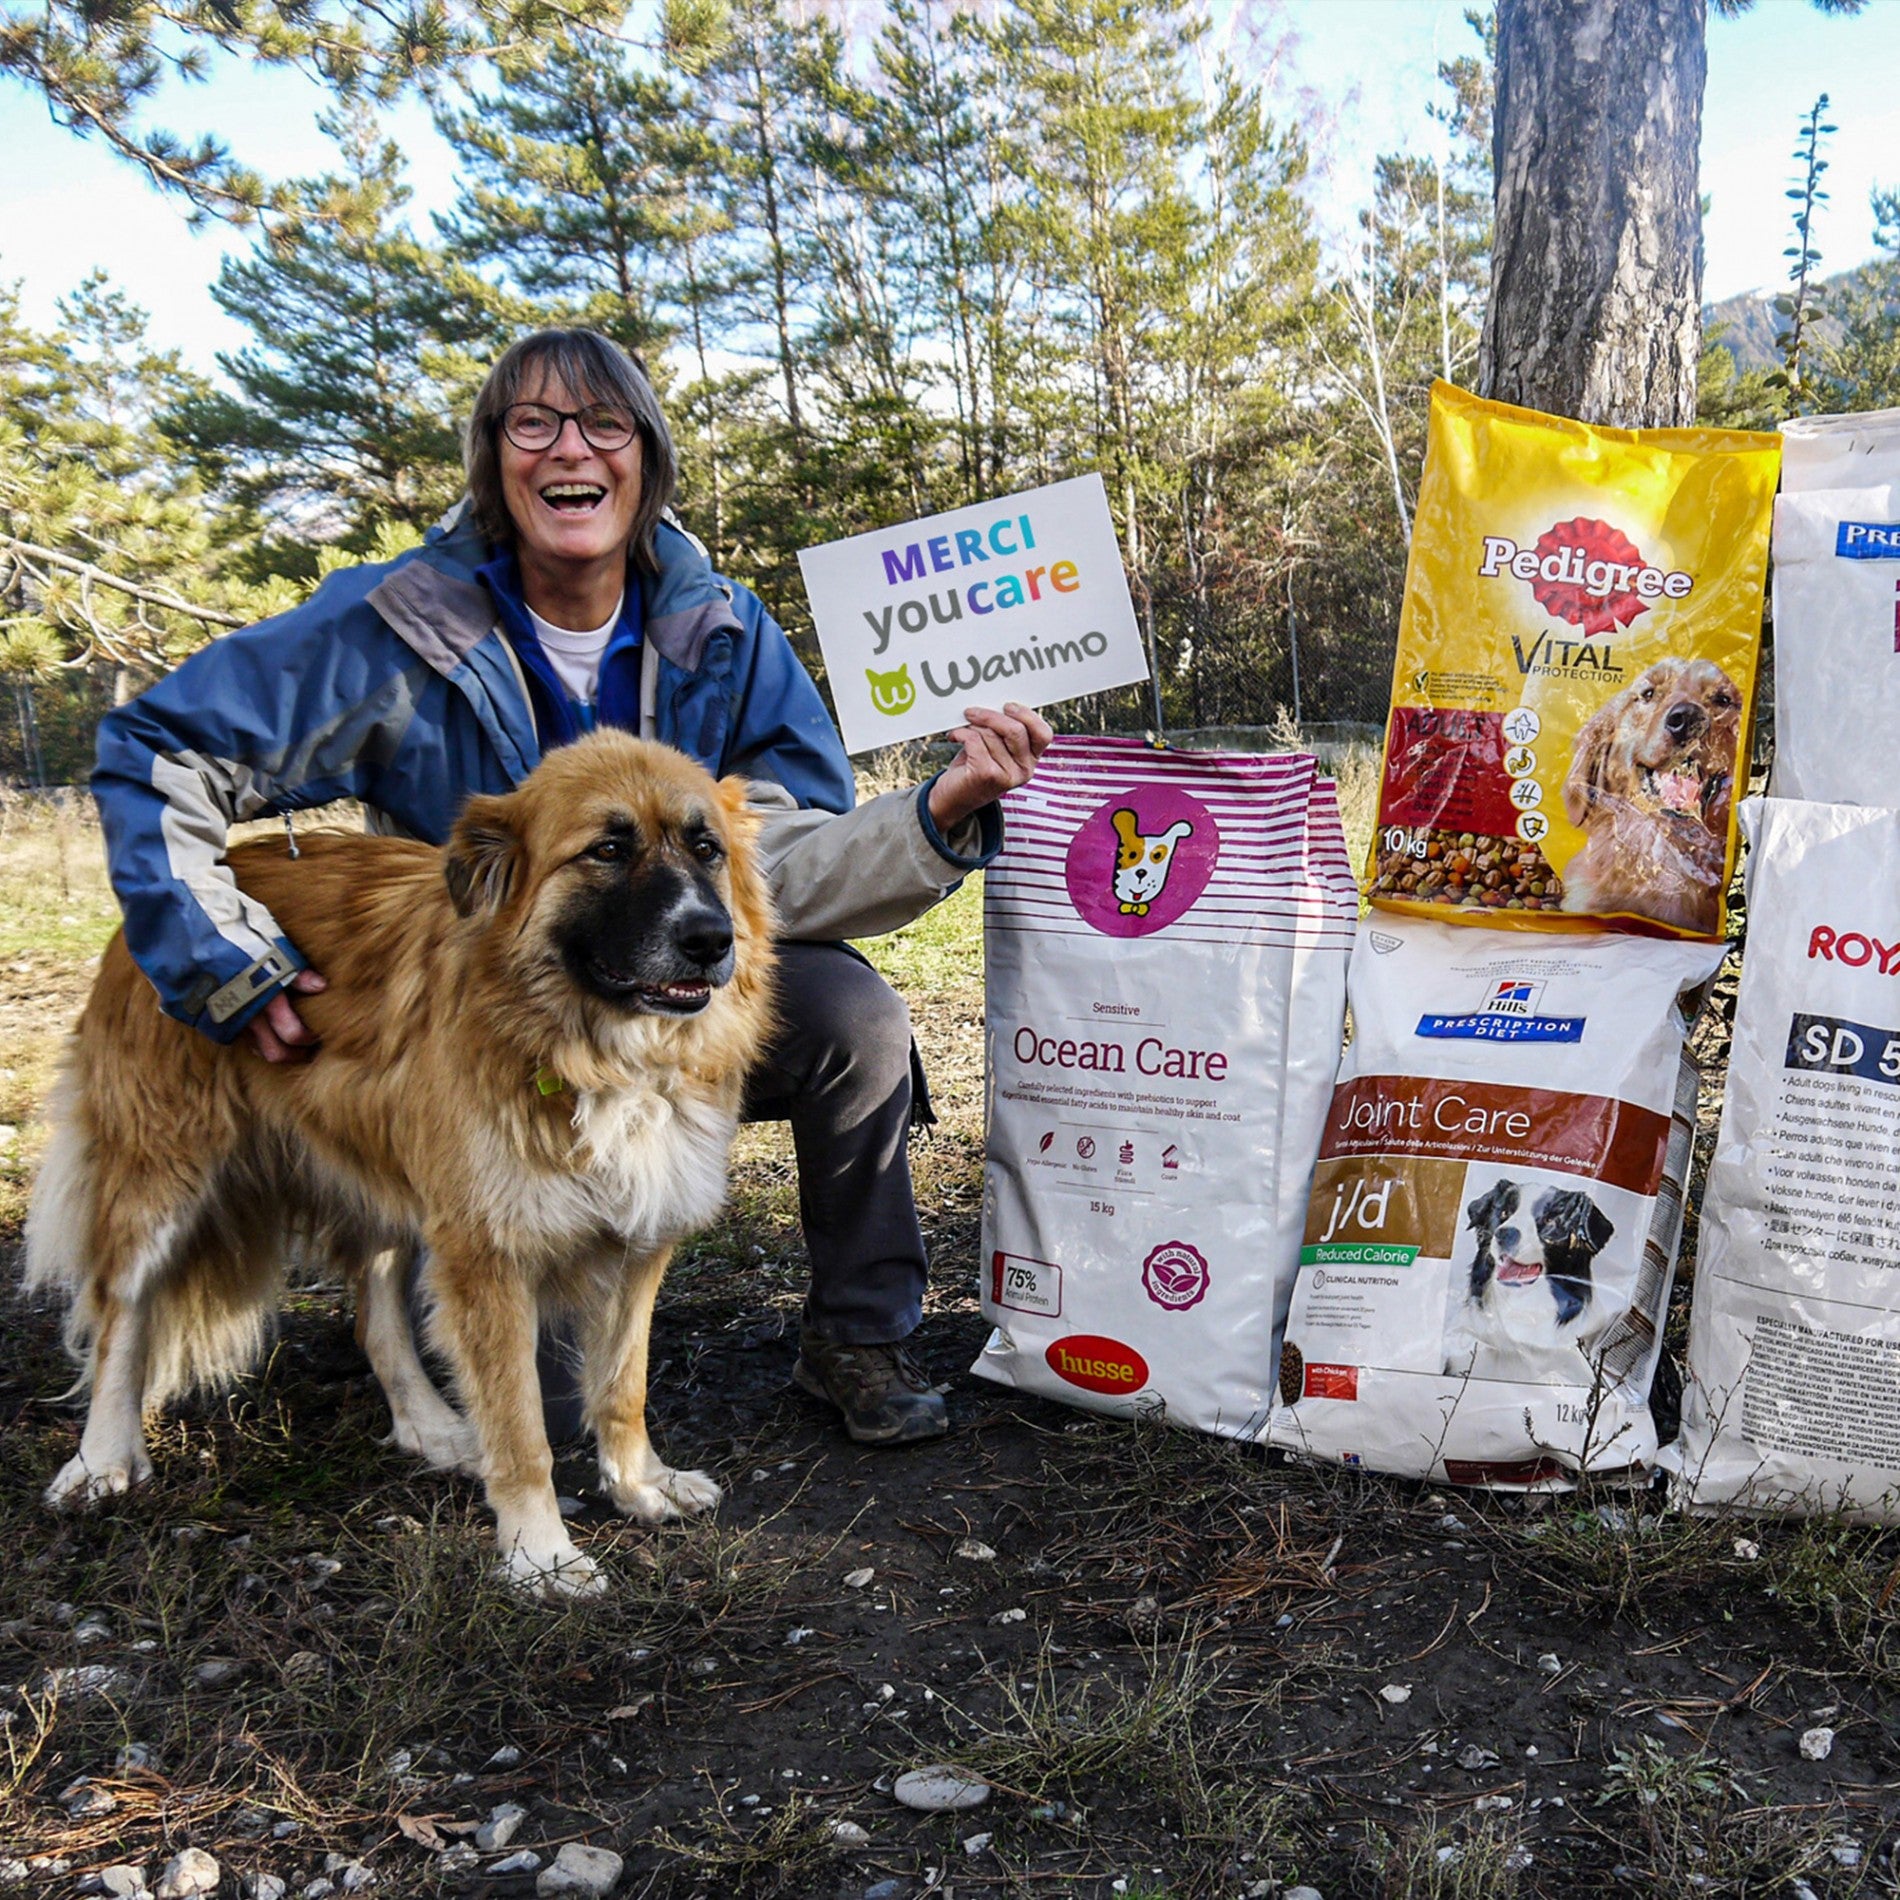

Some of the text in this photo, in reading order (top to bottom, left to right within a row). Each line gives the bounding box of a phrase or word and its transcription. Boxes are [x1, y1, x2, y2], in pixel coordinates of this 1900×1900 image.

[881, 514, 1036, 585] MERCI
[1478, 536, 1694, 600] Pedigree
[862, 559, 1081, 656] youcare
[920, 630, 1108, 698] Wanimo
[1532, 664, 1625, 684] PROTECTION
[1384, 829, 1428, 859] 10 kg
[1807, 924, 1900, 976] ROY
[1092, 1002, 1141, 1017] Sensitive
[1486, 1000, 1529, 1015] Hill's
[1432, 1015, 1572, 1032] PRESCRIPTION
[1475, 1028, 1520, 1039] DIET
[1013, 1026, 1228, 1082] Ocean Care
[1801, 1023, 1865, 1066] SD
[1788, 1074, 1810, 1088] Adult
[1813, 1078, 1835, 1093] dogs
[1837, 1080, 1860, 1096] living
[1863, 1085, 1871, 1096] in
[1071, 1098, 1088, 1110] fatty
[1088, 1100, 1109, 1111] acids
[1109, 1102, 1117, 1111] to
[1118, 1103, 1153, 1115] maintain
[1154, 1107, 1186, 1119] healthy
[1186, 1109, 1204, 1120] skin
[1205, 1112, 1221, 1120] and
[1222, 1113, 1242, 1122] coat
[1117, 1091, 1134, 1100] with
[1176, 1097, 1184, 1106] to
[1185, 1099, 1217, 1109] support
[1785, 1092, 1894, 1118] Chiens adultes vivant en
[1339, 1093, 1532, 1138] Joint Care
[1779, 1129, 1807, 1144] Perros
[1846, 1138, 1862, 1152] que
[1864, 1139, 1889, 1153] viven
[1476, 1143, 1491, 1154] Zur
[1491, 1145, 1549, 1162] Unterstützung
[1548, 1154, 1564, 1164] der
[1563, 1155, 1598, 1170] Gelenke
[1777, 1149, 1796, 1161] ani
[1824, 1153, 1841, 1166] che
[1844, 1155, 1873, 1171] vivono
[1875, 1159, 1884, 1171] in
[1774, 1164, 1793, 1178] Voor
[1845, 1173, 1879, 1190] honden
[1882, 1179, 1896, 1192] die
[1090, 1201, 1115, 1217] 15 kg
[1319, 1178, 1393, 1243] j/d
[1856, 1192, 1880, 1209] lever
[1155, 1248, 1202, 1275] with natural
[1315, 1248, 1410, 1264] Reduced Calorie
[1006, 1265, 1037, 1292] 75%
[1325, 1275, 1399, 1286] CLINICAL NUTRITION
[1151, 1280, 1196, 1303] ingredients
[1756, 1315, 1796, 1332] ESPECIALLY
[1864, 1336, 1883, 1348] FOR
[1793, 1343, 1823, 1356] FABRICADO
[1824, 1349, 1840, 1359] PARA
[1851, 1354, 1864, 1363] USO
[1865, 1357, 1874, 1365] EN
[1848, 1344, 1877, 1356] REFUGES
[1058, 1347, 1135, 1383] husse
[1807, 1355, 1834, 1367] SPECIAAL
[1836, 1359, 1882, 1375] GEFABRICEERD
[1838, 1387, 1858, 1397] TUOTE
[1556, 1404, 1588, 1426] 12 kg
[1825, 1411, 1834, 1419] DO
[1848, 1424, 1873, 1434] PRODUS
